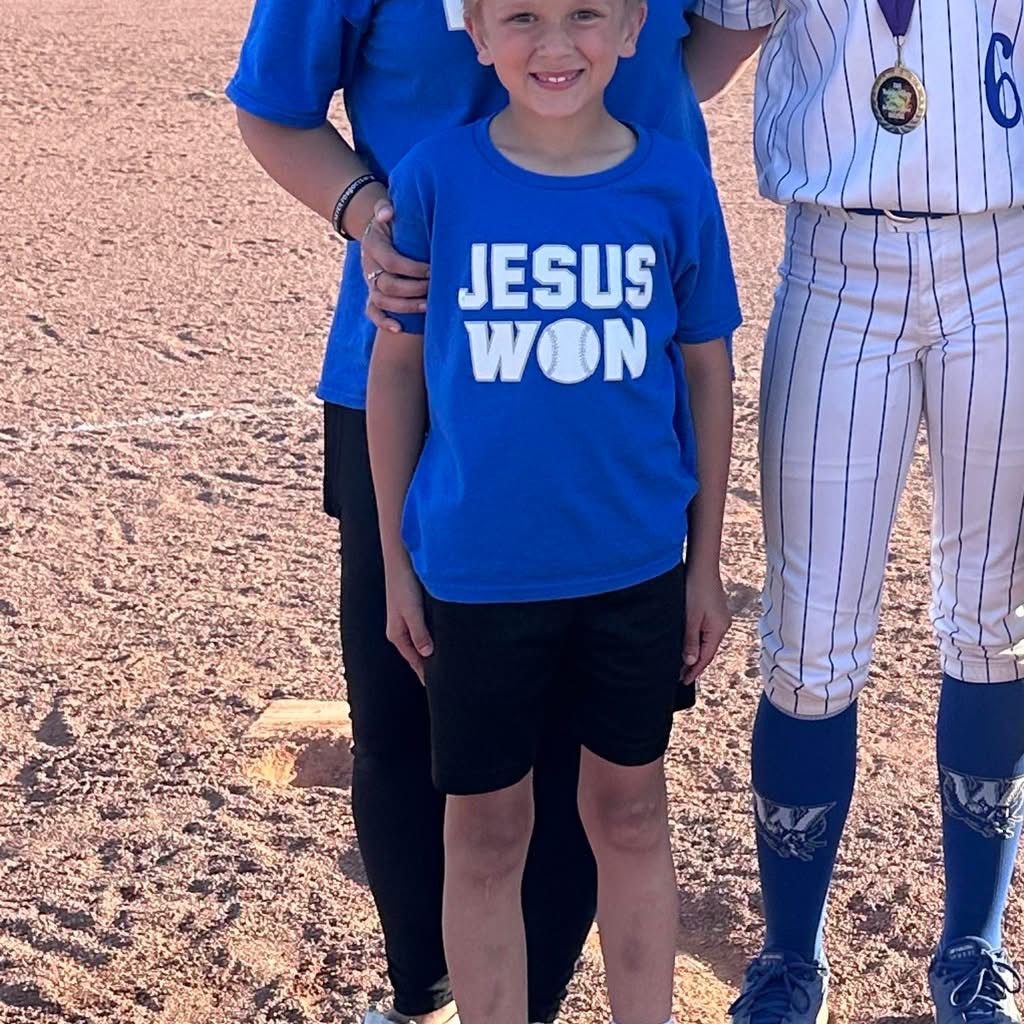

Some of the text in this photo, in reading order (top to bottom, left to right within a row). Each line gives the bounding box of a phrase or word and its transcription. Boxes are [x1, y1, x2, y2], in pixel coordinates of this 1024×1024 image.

[984, 32, 1022, 128] 6
[458, 243, 656, 309] JESUS
[463, 317, 647, 384] WON
